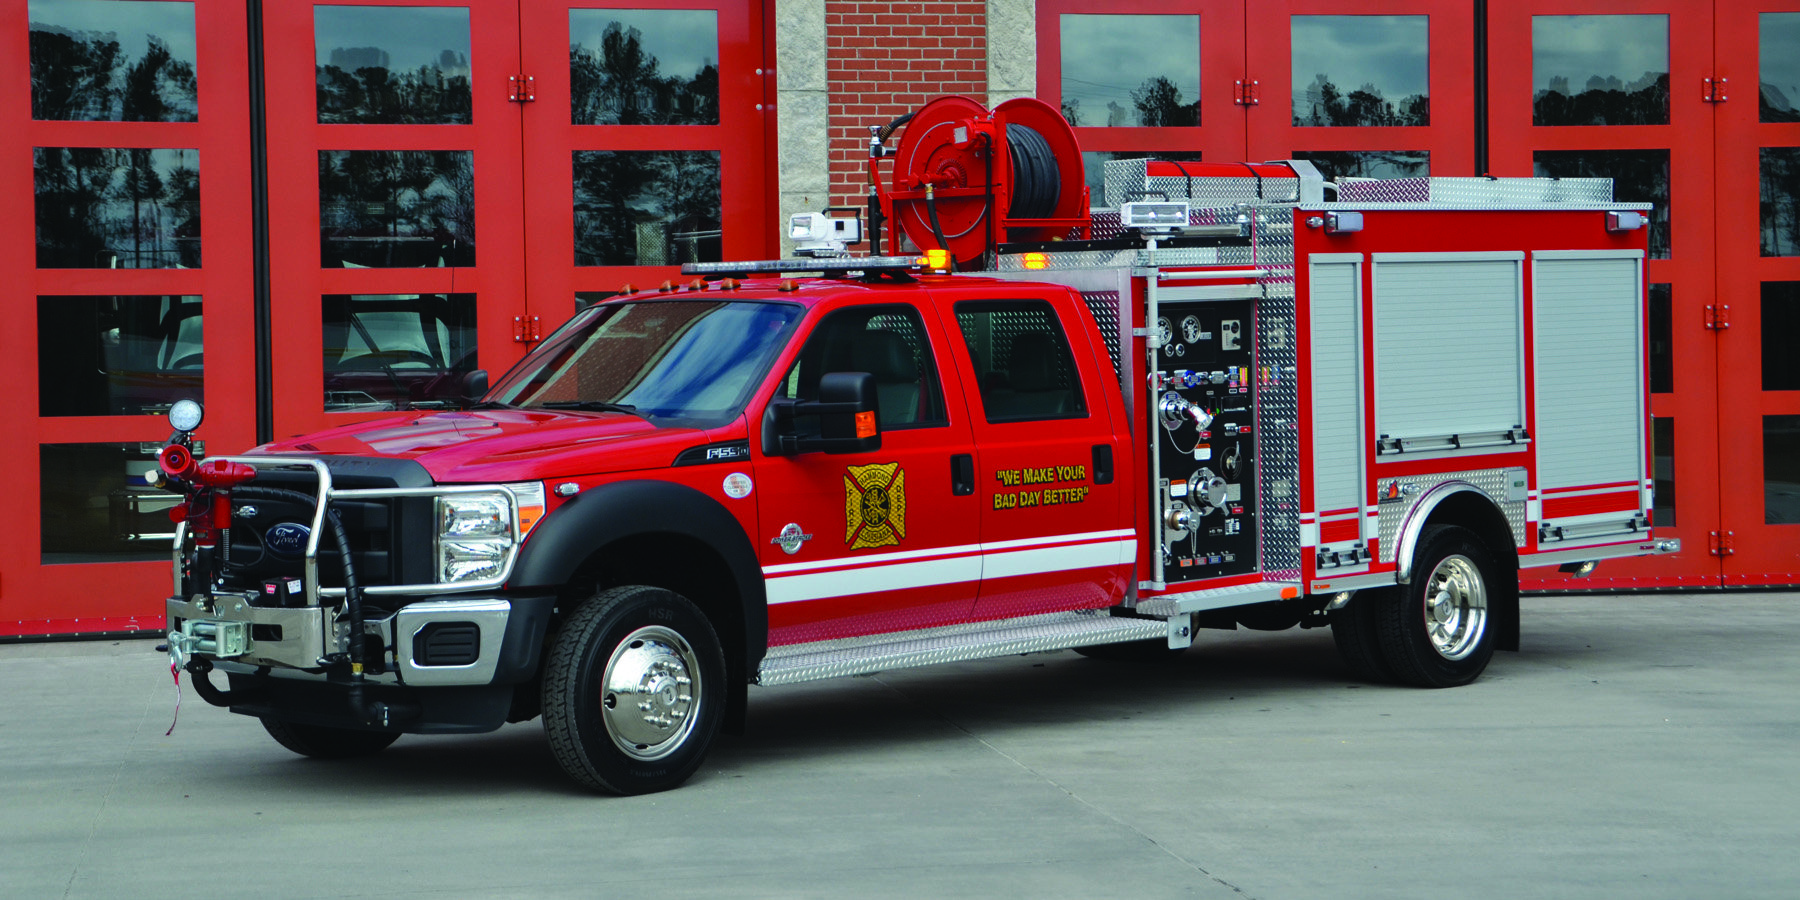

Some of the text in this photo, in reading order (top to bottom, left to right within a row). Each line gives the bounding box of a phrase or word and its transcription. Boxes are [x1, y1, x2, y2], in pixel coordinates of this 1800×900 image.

[1022, 467, 1055, 485] MAKE
[1055, 465, 1086, 482] YOUR
[993, 493, 1017, 511] BAD
[1019, 491, 1041, 508] DAY
[273, 528, 301, 547] Ford
